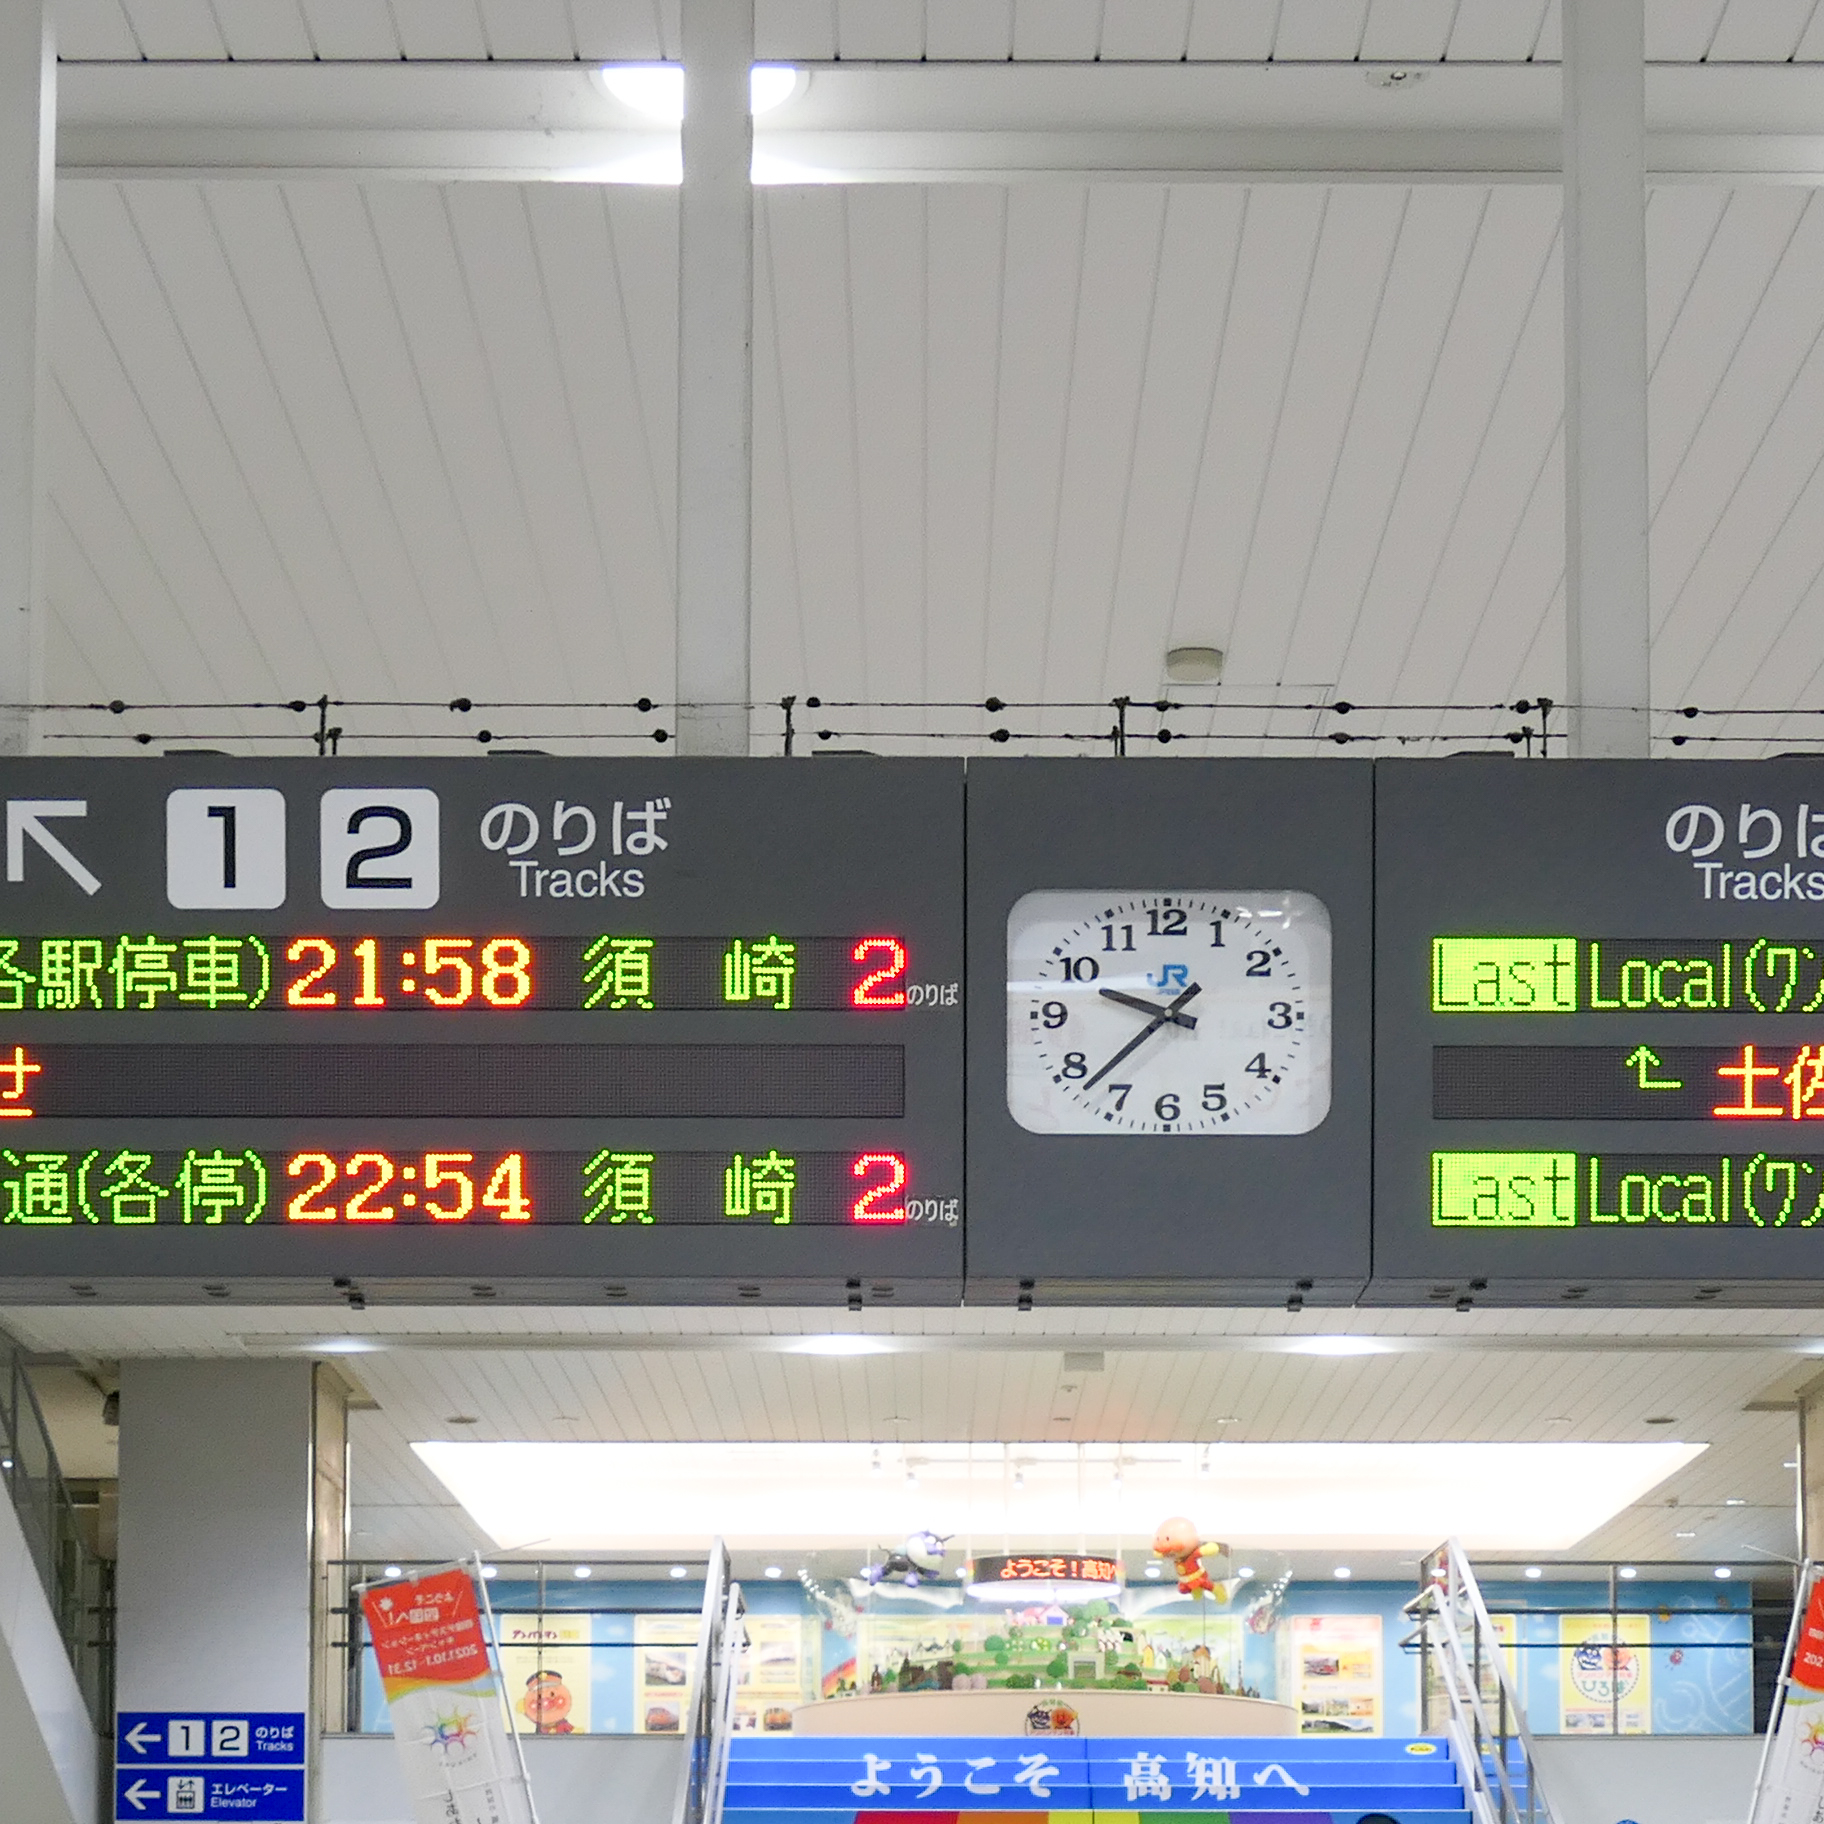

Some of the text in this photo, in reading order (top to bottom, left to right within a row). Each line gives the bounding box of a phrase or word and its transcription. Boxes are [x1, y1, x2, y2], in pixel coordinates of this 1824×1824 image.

[206, 797, 671, 890] 1 2 のりば
[509, 860, 644, 900] Tracks
[1147, 908, 1188, 936] 12
[1209, 920, 1226, 948] 1
[1101, 924, 1137, 951] 11
[286, 938, 532, 1008] 21:58
[850, 939, 906, 1007] 2
[907, 980, 959, 1008] のりば
[1060, 956, 1100, 983] 10
[1146, 964, 1189, 988] JR
[1246, 950, 1272, 978] 2
[1432, 937, 1577, 1011] Last
[1041, 1001, 1068, 1029] 9
[1267, 1002, 1294, 1029] 3
[1061, 1052, 1088, 1079] 8
[1244, 1052, 1272, 1079] 4
[1108, 1084, 1133, 1111] 7
[1155, 1093, 1181, 1121] 6
[1201, 1083, 1227, 1111] 5
[286, 1153, 532, 1223] 22:54
[850, 1153, 906, 1222] 2
[905, 1196, 959, 1225] のりば
[1432, 1151, 1577, 1225] Last
[180, 1726, 294, 1751] 1 2 のりば
[256, 1740, 294, 1751] Tracks
[211, 1783, 288, 1795] エレベーター
[851, 1751, 1310, 1802] ようこそ 高知へ
[210, 1797, 257, 1808] Elevator
